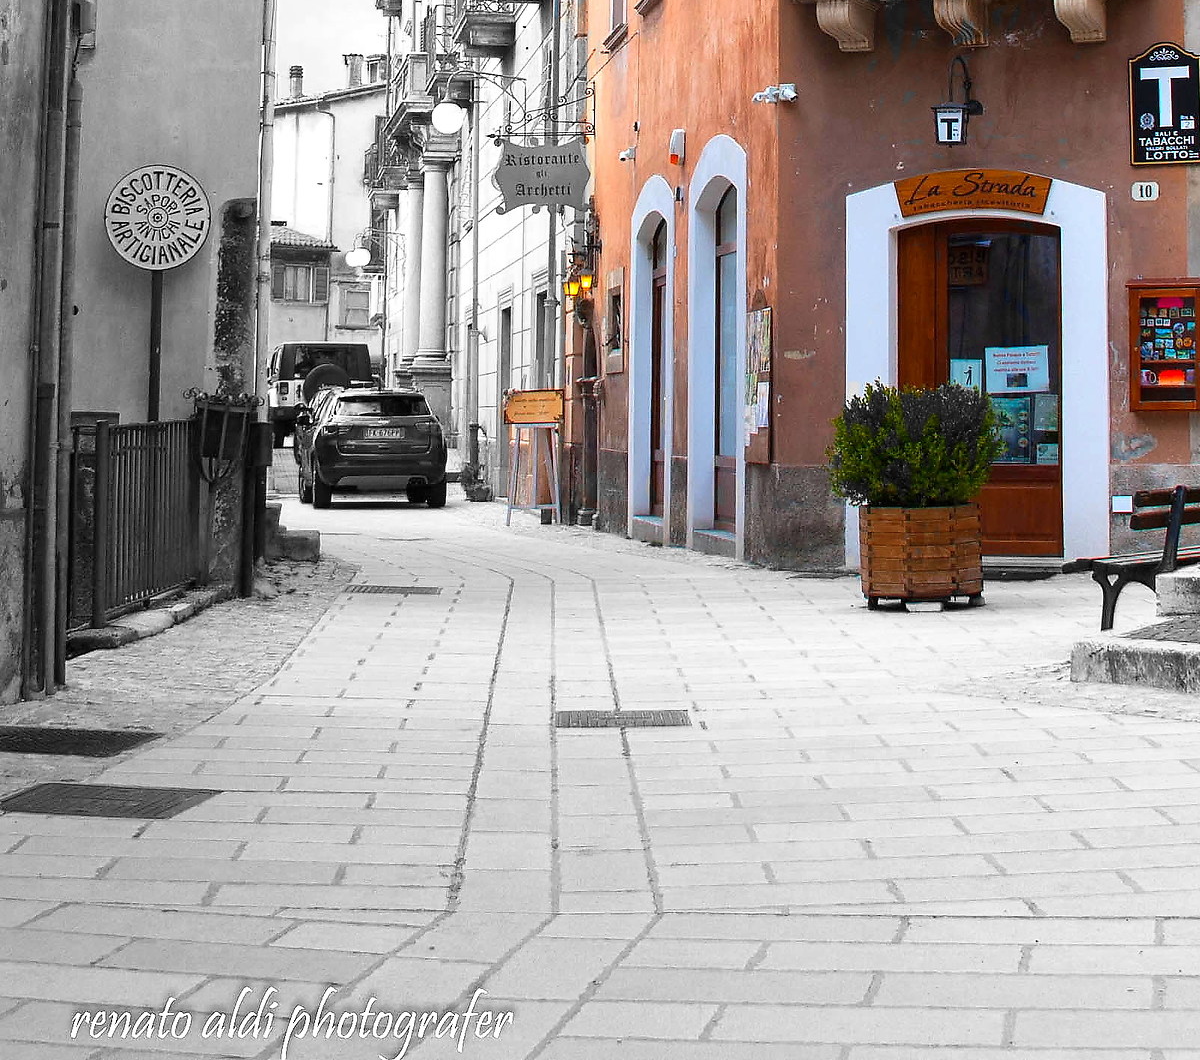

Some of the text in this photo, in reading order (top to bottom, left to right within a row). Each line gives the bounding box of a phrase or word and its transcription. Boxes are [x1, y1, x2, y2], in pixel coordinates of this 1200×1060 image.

[1140, 65, 1189, 128] T
[940, 118, 959, 140] T
[1139, 135, 1195, 147] TABACCHI
[505, 153, 580, 166] Ristorante
[1145, 150, 1188, 160] LOTTO
[111, 171, 204, 215] BISCOTTERIA
[515, 182, 571, 197] Archetti
[904, 172, 1037, 206] La Strada
[1139, 184, 1152, 198] 10
[136, 194, 181, 215] SAPORI
[134, 220, 181, 241] ANTICHI
[111, 219, 205, 265] ARTIGIANALE
